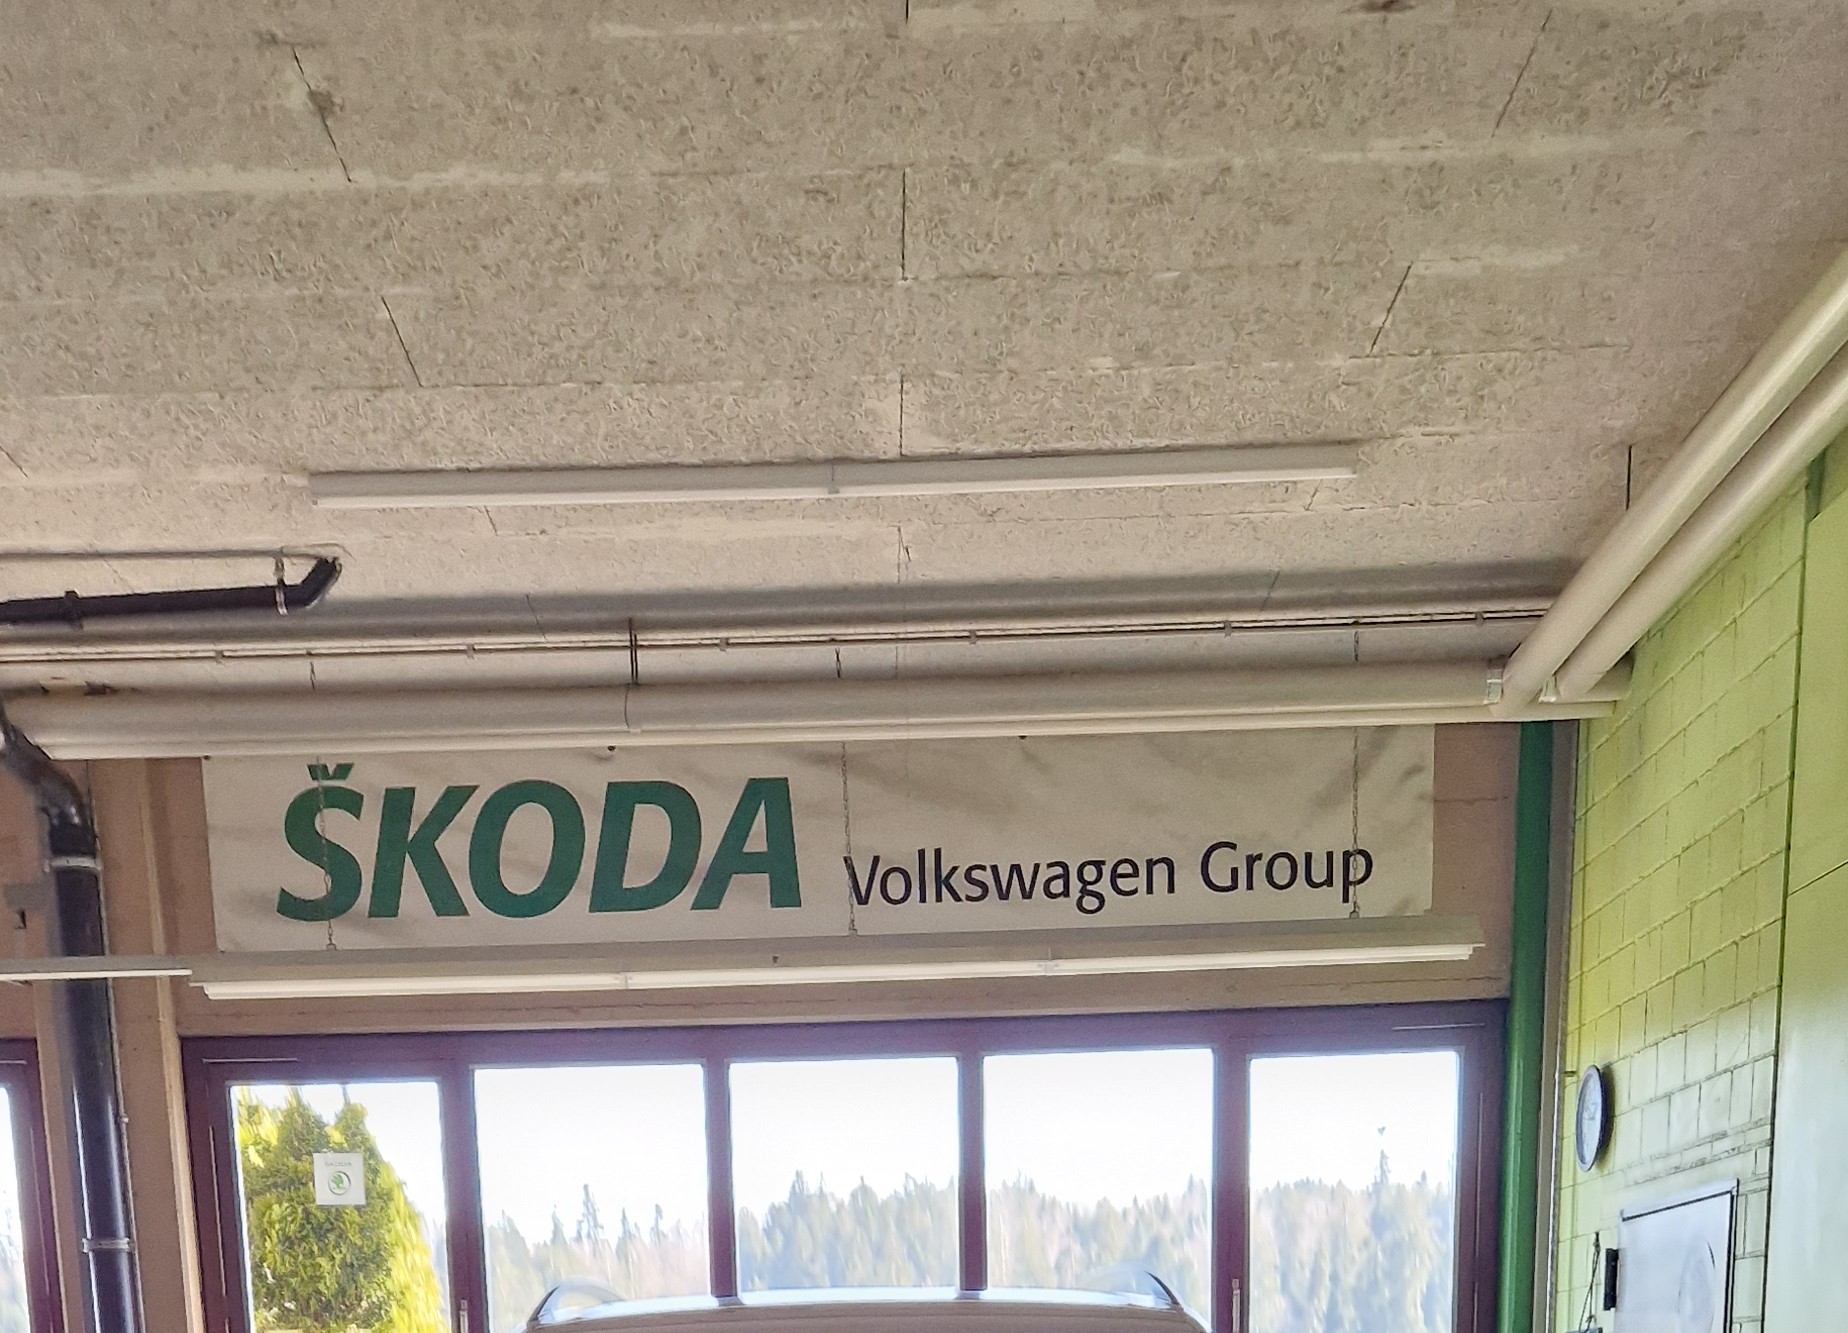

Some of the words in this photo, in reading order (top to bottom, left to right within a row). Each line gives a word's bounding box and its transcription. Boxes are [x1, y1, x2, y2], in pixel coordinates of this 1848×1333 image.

[277, 762, 801, 921] ŠKODA
[843, 847, 1176, 915] Volkswagen
[1201, 841, 1374, 904] Group
